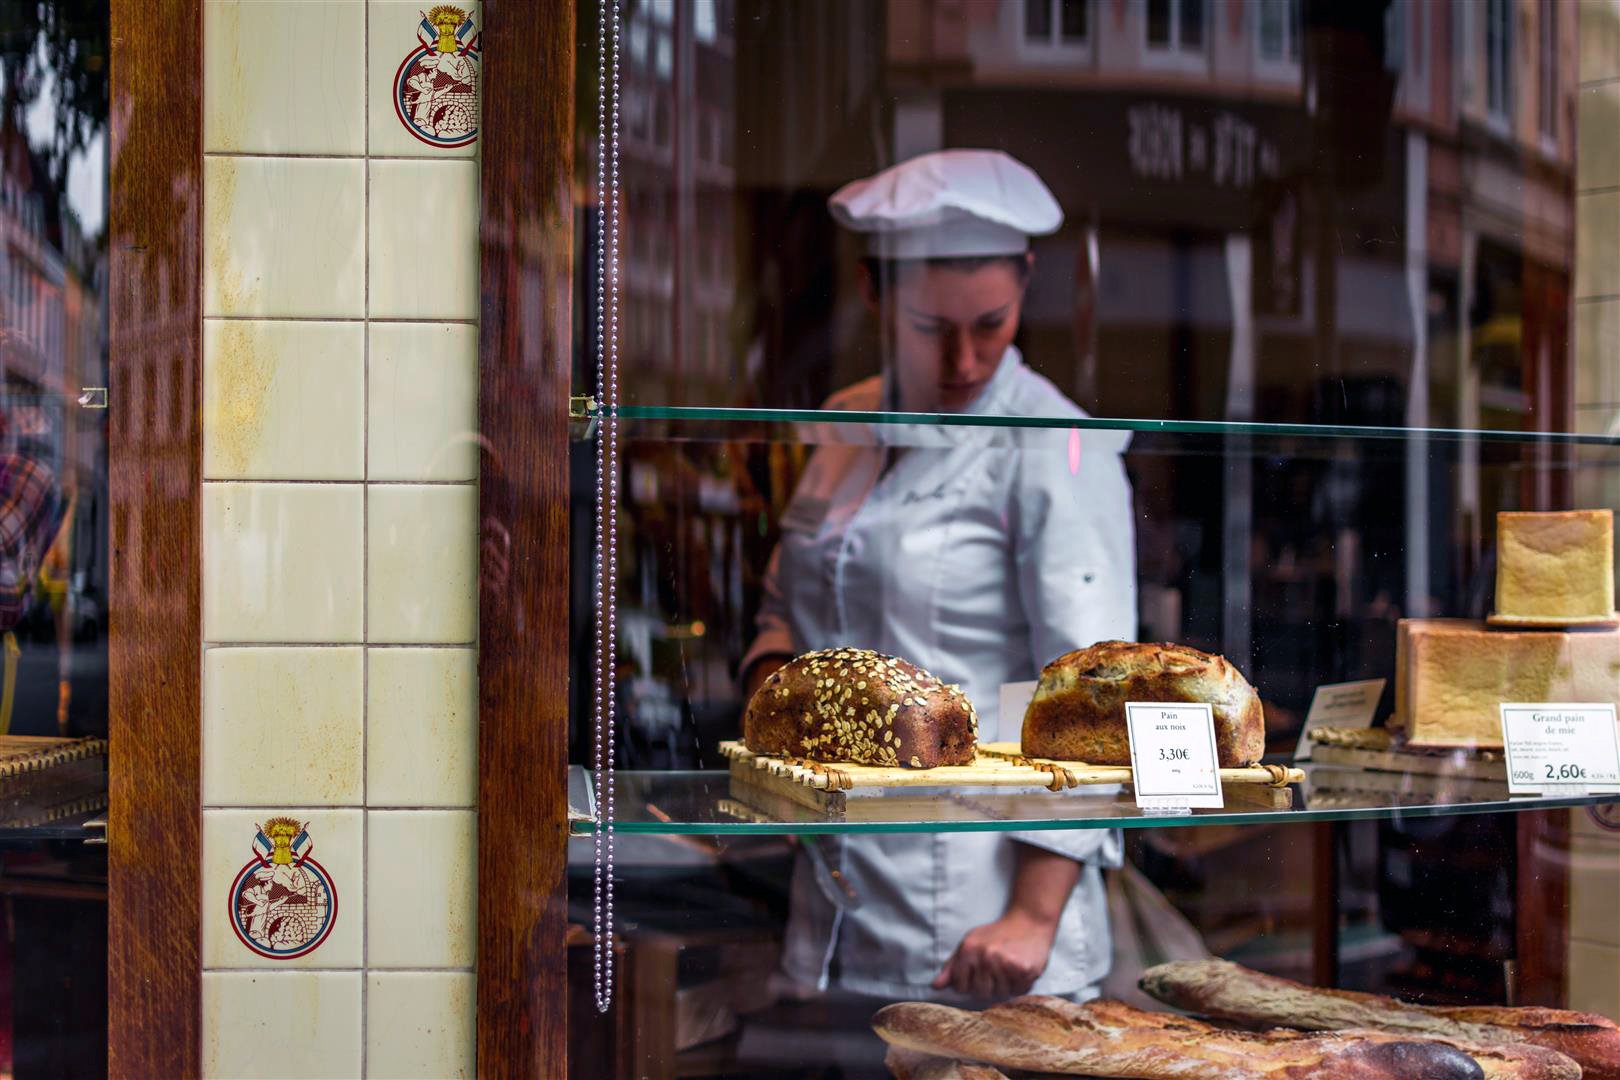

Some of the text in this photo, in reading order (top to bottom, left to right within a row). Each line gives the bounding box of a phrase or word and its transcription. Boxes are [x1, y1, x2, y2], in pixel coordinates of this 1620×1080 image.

[1161, 711, 1178, 719] Pain
[1532, 713, 1585, 724] Grand pain
[1170, 722, 1186, 730] noix
[1545, 726, 1575, 734] de mie
[1159, 748, 1190, 761] 3,30€
[1513, 770, 1535, 780] 600g
[1544, 764, 1587, 780] 2,60€
